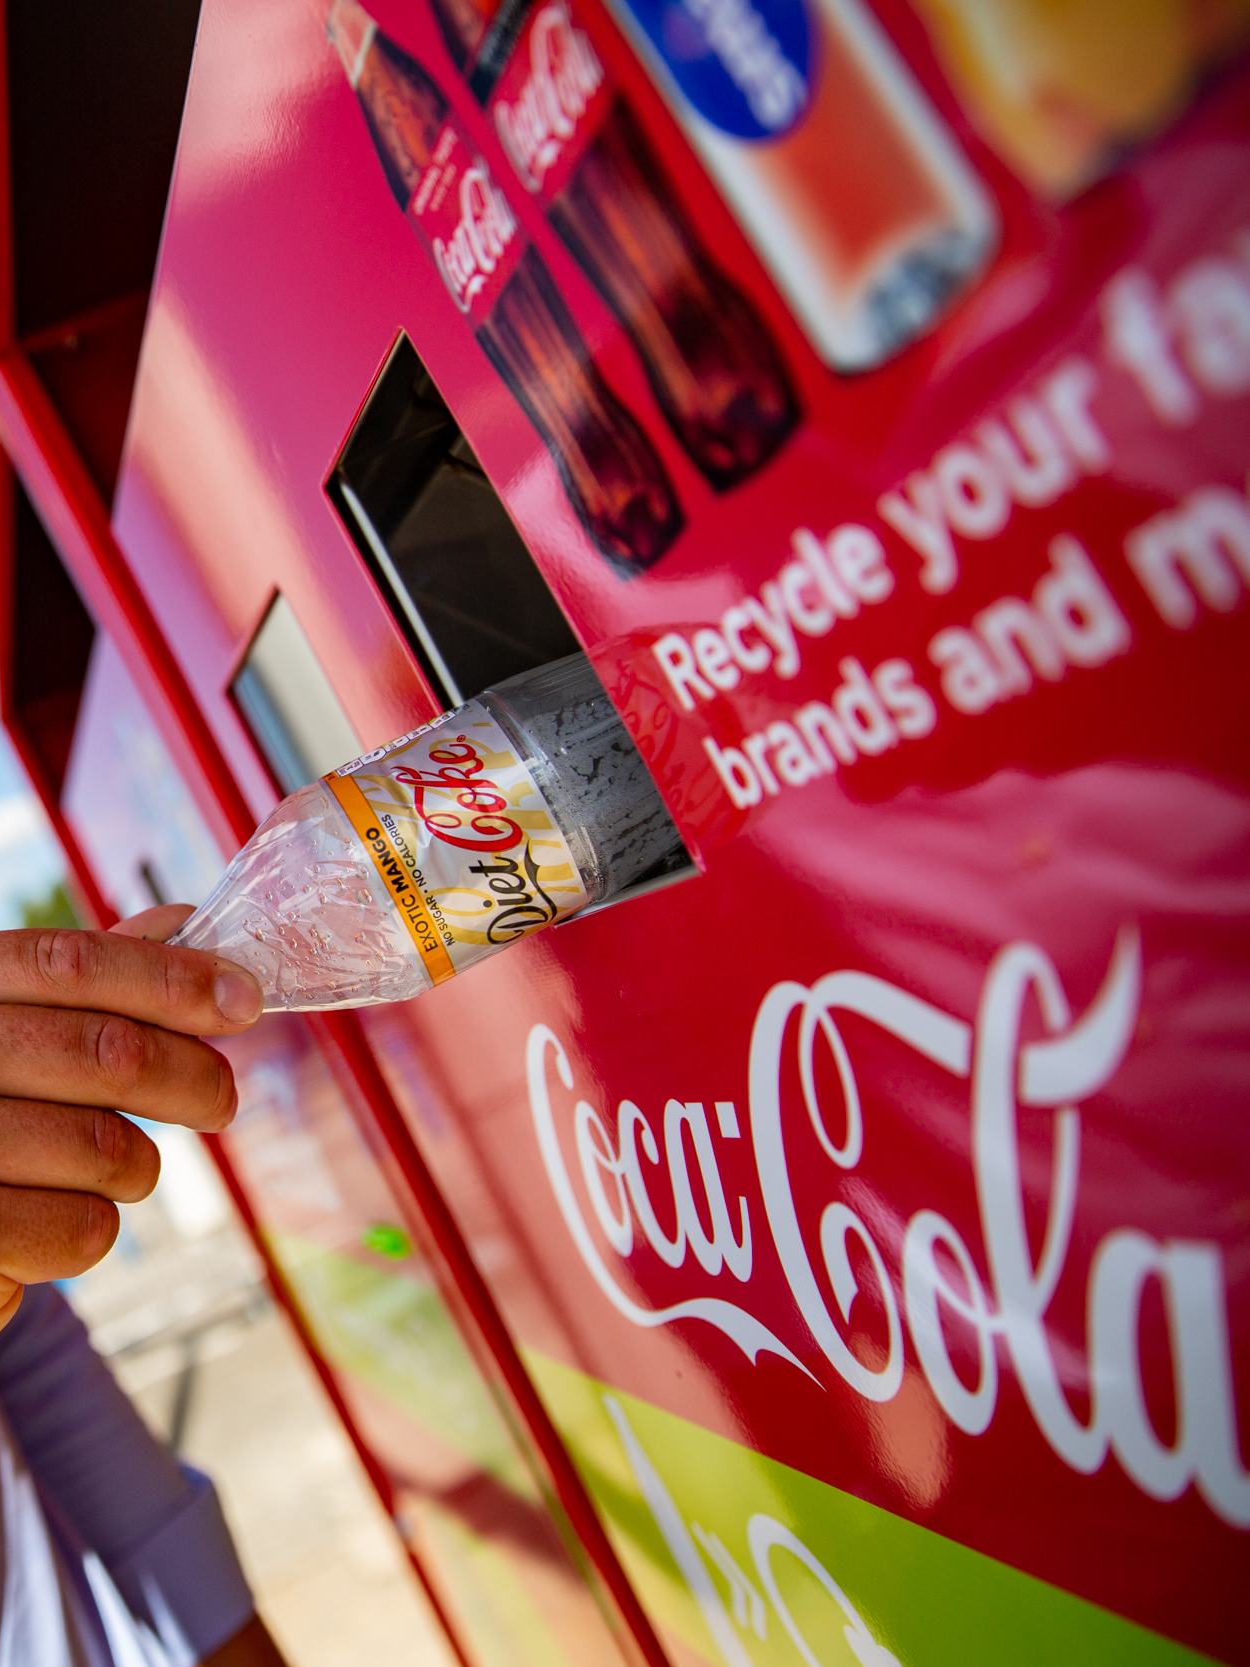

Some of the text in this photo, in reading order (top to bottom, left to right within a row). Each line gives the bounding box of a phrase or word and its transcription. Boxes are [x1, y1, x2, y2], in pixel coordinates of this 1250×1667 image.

[653, 228, 1250, 713] Recycle your fa
[702, 478, 1250, 810] brands and m
[390, 742, 524, 853] Coke
[365, 827, 439, 953] EXOTIC MANGO
[381, 813, 456, 947] NO SUGAR NO CALORIES
[468, 838, 558, 945] Diet
[526, 926, 1250, 1532] Coca-Cola
